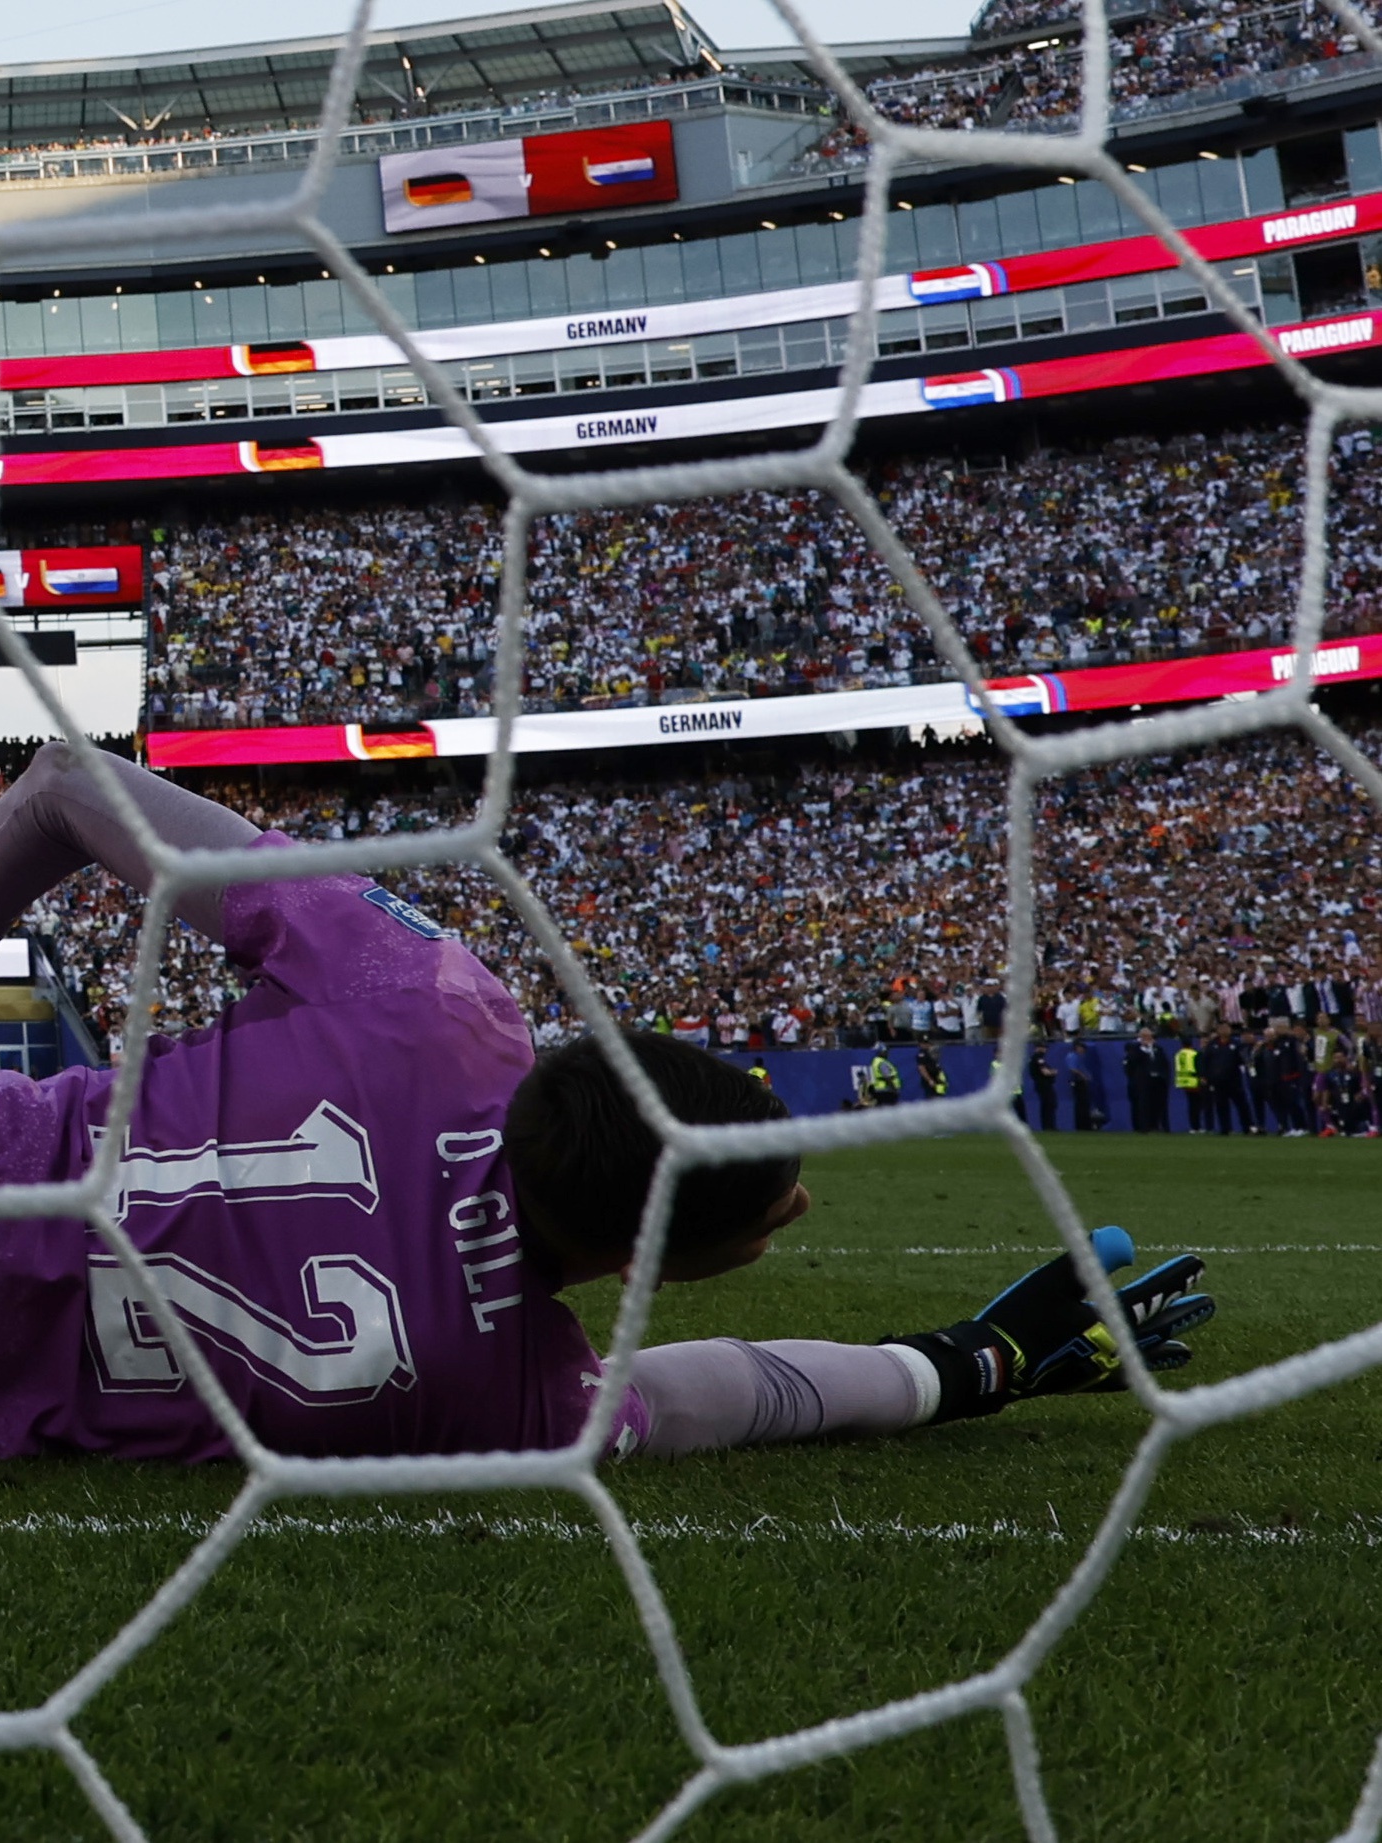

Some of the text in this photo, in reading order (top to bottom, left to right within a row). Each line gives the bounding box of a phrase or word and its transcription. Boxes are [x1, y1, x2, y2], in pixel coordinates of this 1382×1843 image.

[1262, 204, 1357, 244] PARAGUAY
[567, 316, 647, 340] GERMANY
[1278, 317, 1373, 354] PARAGUAY
[576, 416, 657, 439] GERMANY
[1271, 645, 1359, 681] PAAGUAY
[659, 710, 742, 734] GERMANY
[85, 1100, 417, 1407] 12
[449, 1190, 523, 1333] GILL
